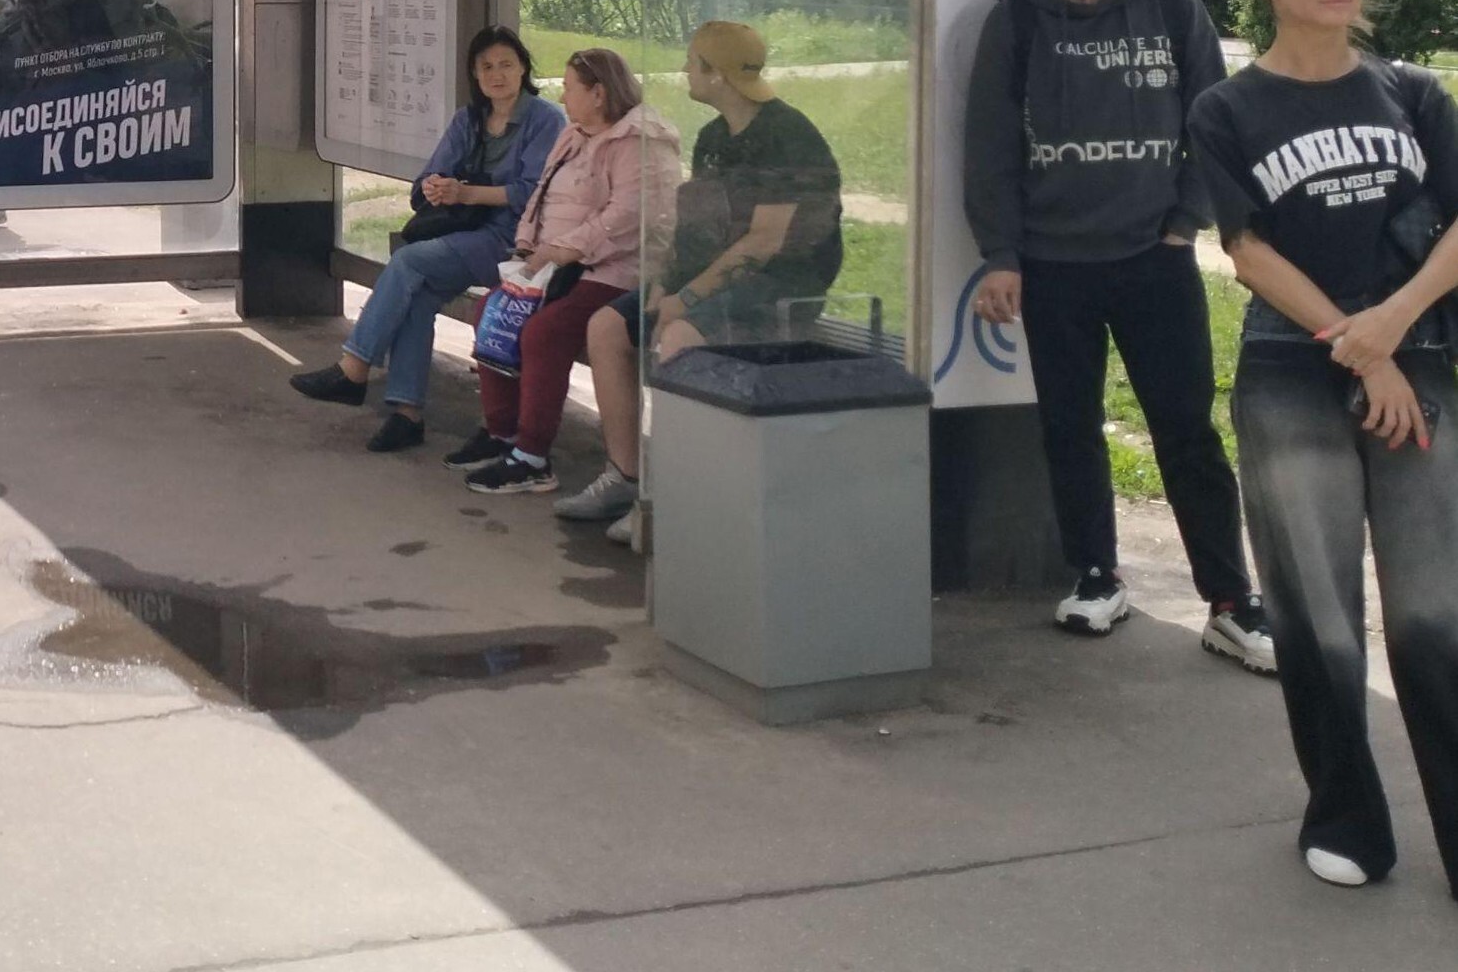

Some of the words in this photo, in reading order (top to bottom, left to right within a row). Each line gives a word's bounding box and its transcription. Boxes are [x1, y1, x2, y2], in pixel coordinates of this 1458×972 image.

[14, 55, 39, 69] ПУНКТ
[39, 49, 68, 64] ОТБОРА
[68, 47, 80, 59] НА
[80, 41, 111, 56] СЛУЖБУ
[111, 38, 122, 51] ПО
[42, 132, 64, 175] К
[74, 106, 191, 169] СВОИМ
[1306, 179, 1341, 196] UPPER
[1342, 173, 1373, 190] WEST
[1326, 192, 1353, 207] NEW
[1355, 186, 1386, 202] YORK
